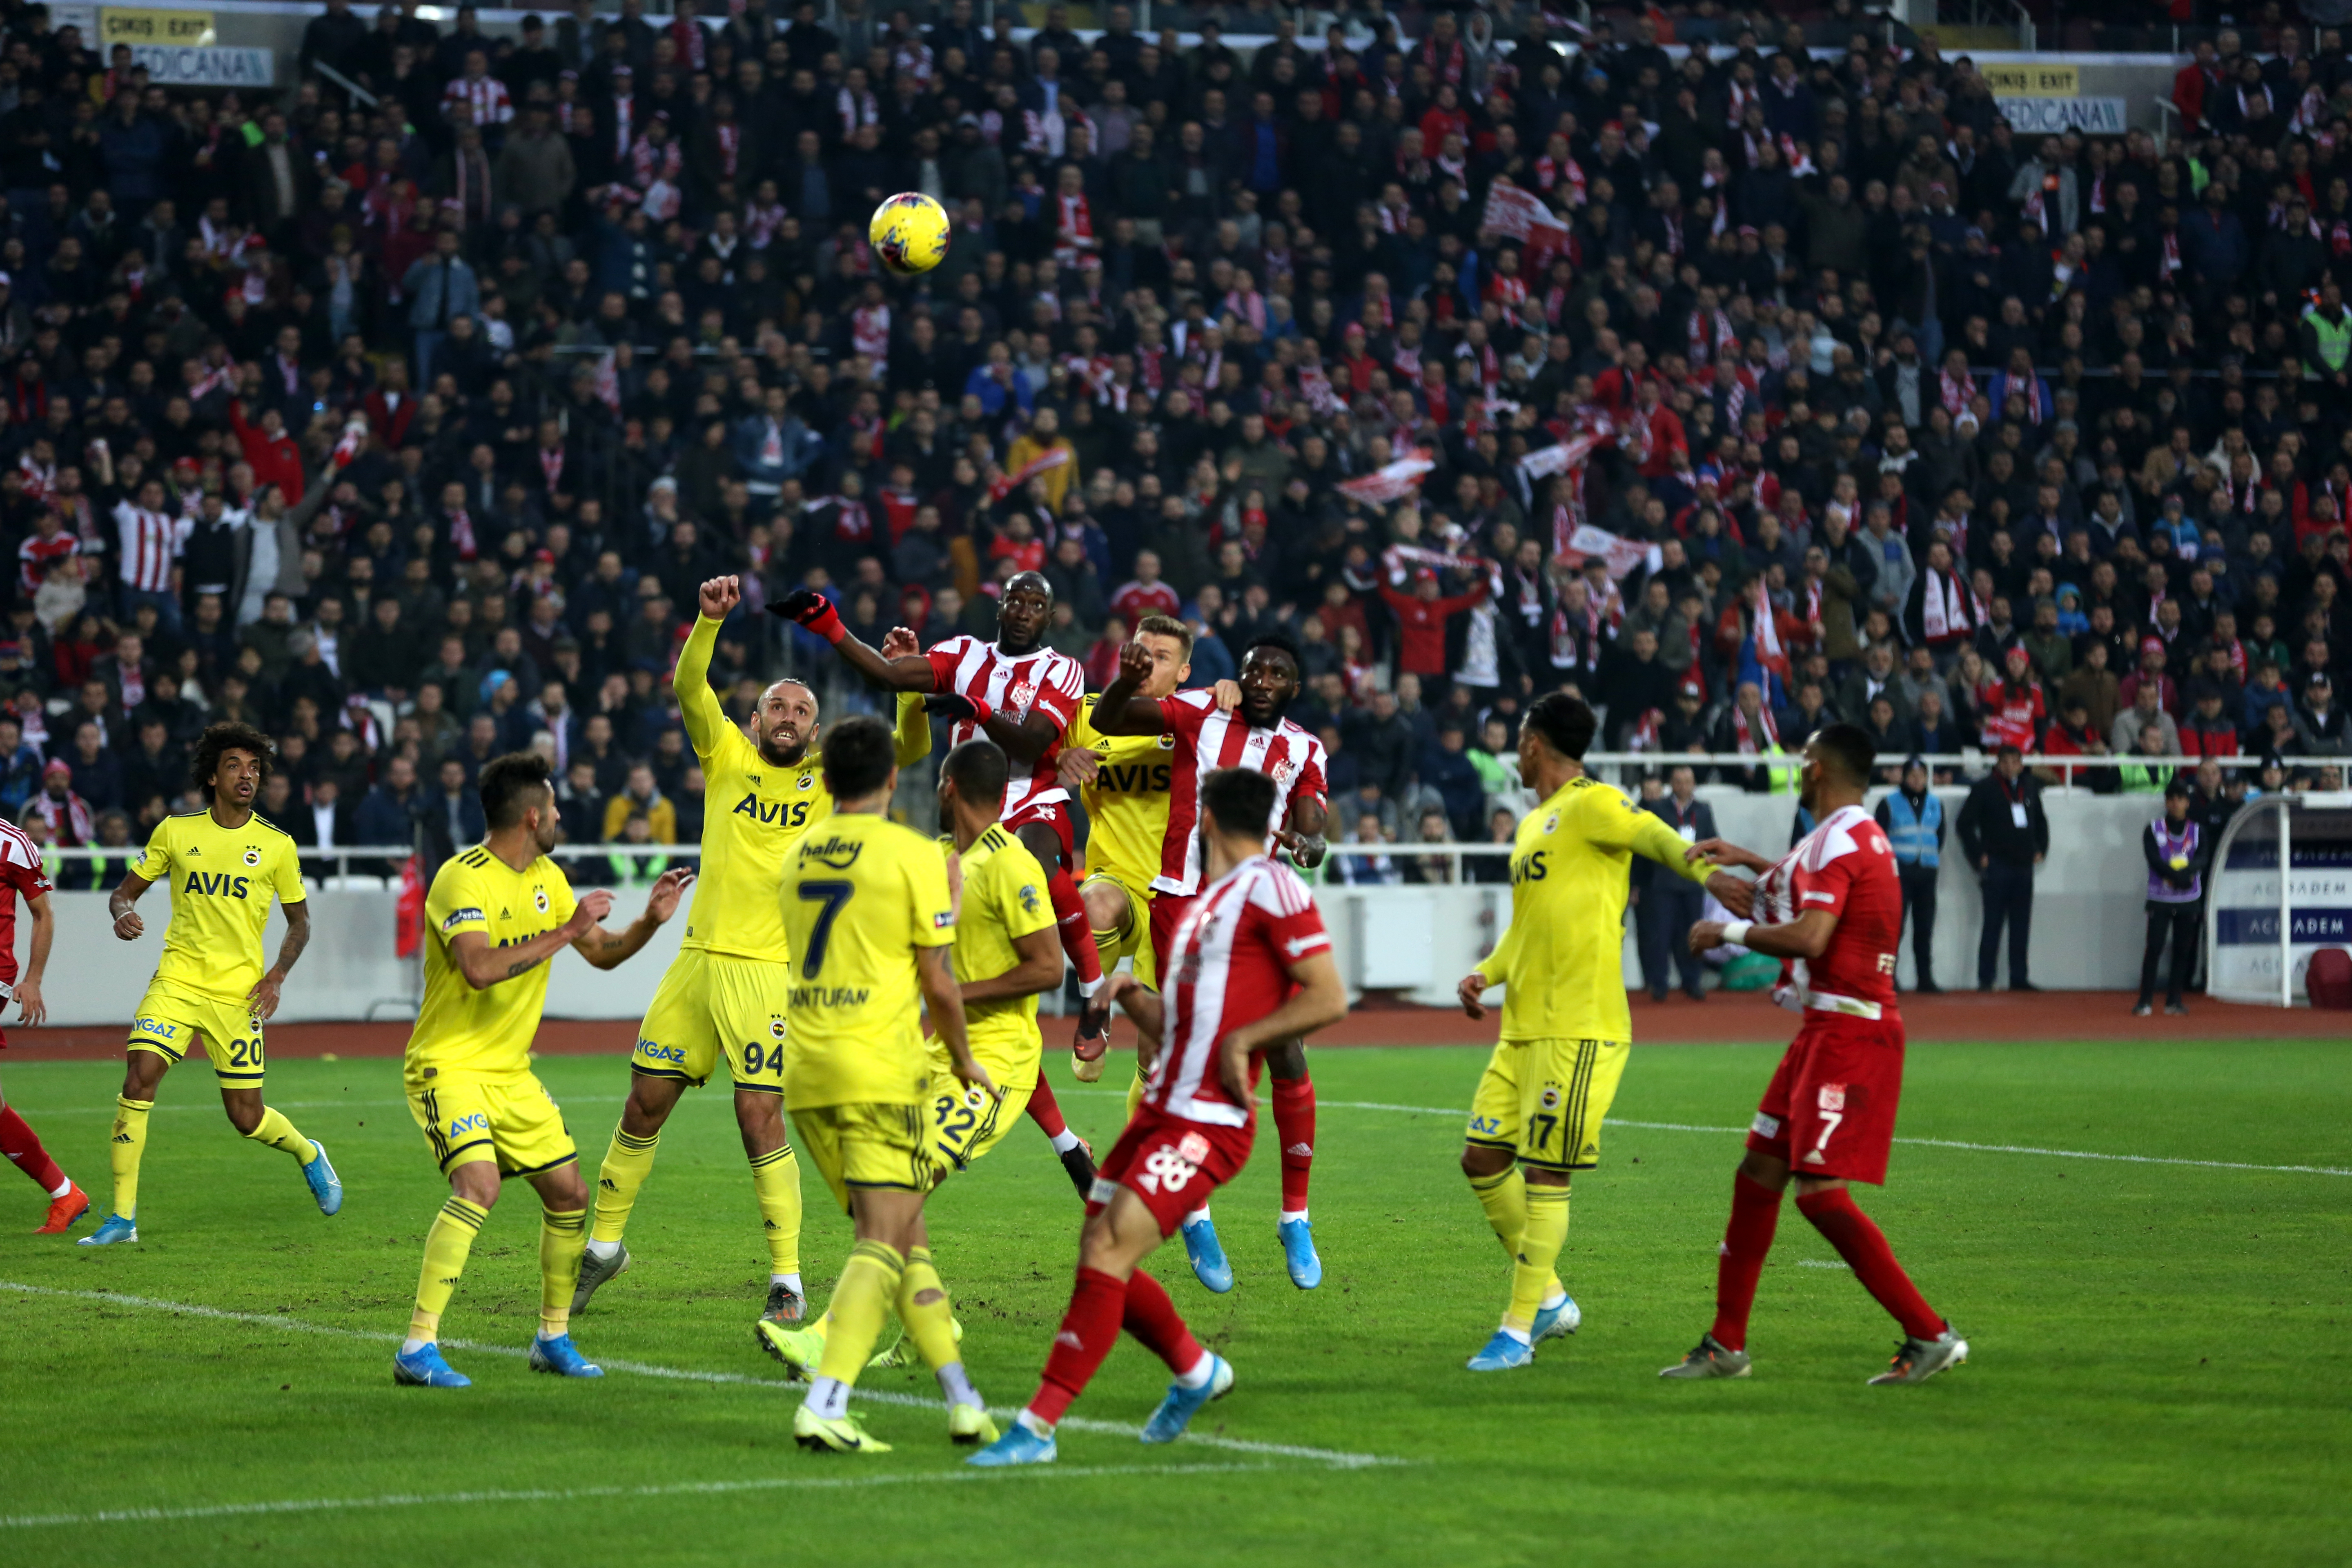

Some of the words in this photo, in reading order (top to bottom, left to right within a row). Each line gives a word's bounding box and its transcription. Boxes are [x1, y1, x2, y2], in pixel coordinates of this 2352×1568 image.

[2040, 71, 2072, 90] EXIT
[1097, 764, 1172, 792] AVIS
[733, 793, 809, 826] AVIS
[799, 837, 863, 869] halley
[184, 871, 250, 900] AVIS
[799, 879, 855, 980] 7
[230, 1038, 261, 1067] 20
[636, 1036, 686, 1063] YGAZ
[744, 1042, 784, 1077] 94
[935, 1096, 976, 1143] 32
[1528, 1113, 1558, 1149] 17
[1819, 1110, 1843, 1150] 7
[1287, 1149, 1313, 1157] adidas
